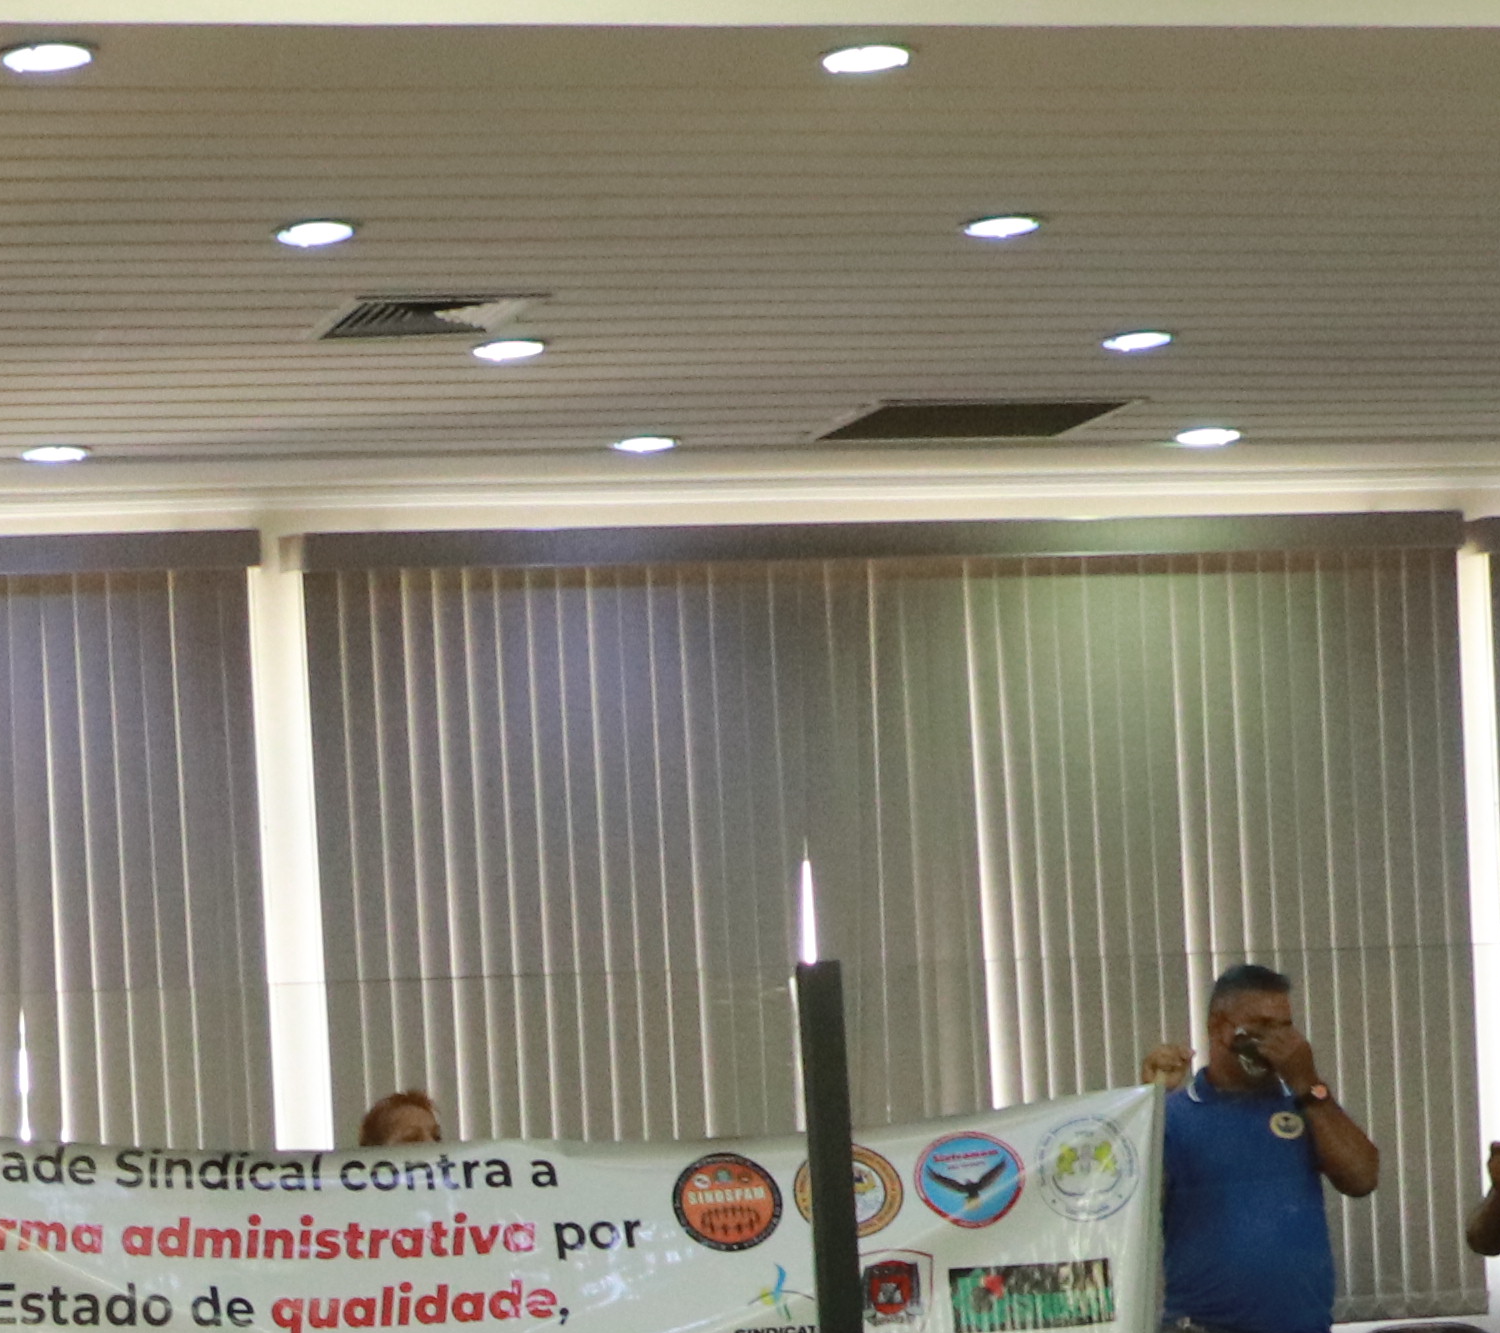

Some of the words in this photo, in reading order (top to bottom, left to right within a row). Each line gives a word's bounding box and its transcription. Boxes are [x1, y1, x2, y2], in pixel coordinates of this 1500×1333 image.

[115, 1149, 324, 1192] Sindical
[339, 1154, 513, 1192] contra
[530, 1159, 559, 1188] a
[121, 1211, 536, 1259] administrativa
[553, 1218, 642, 1261] por
[191, 1285, 255, 1328] de
